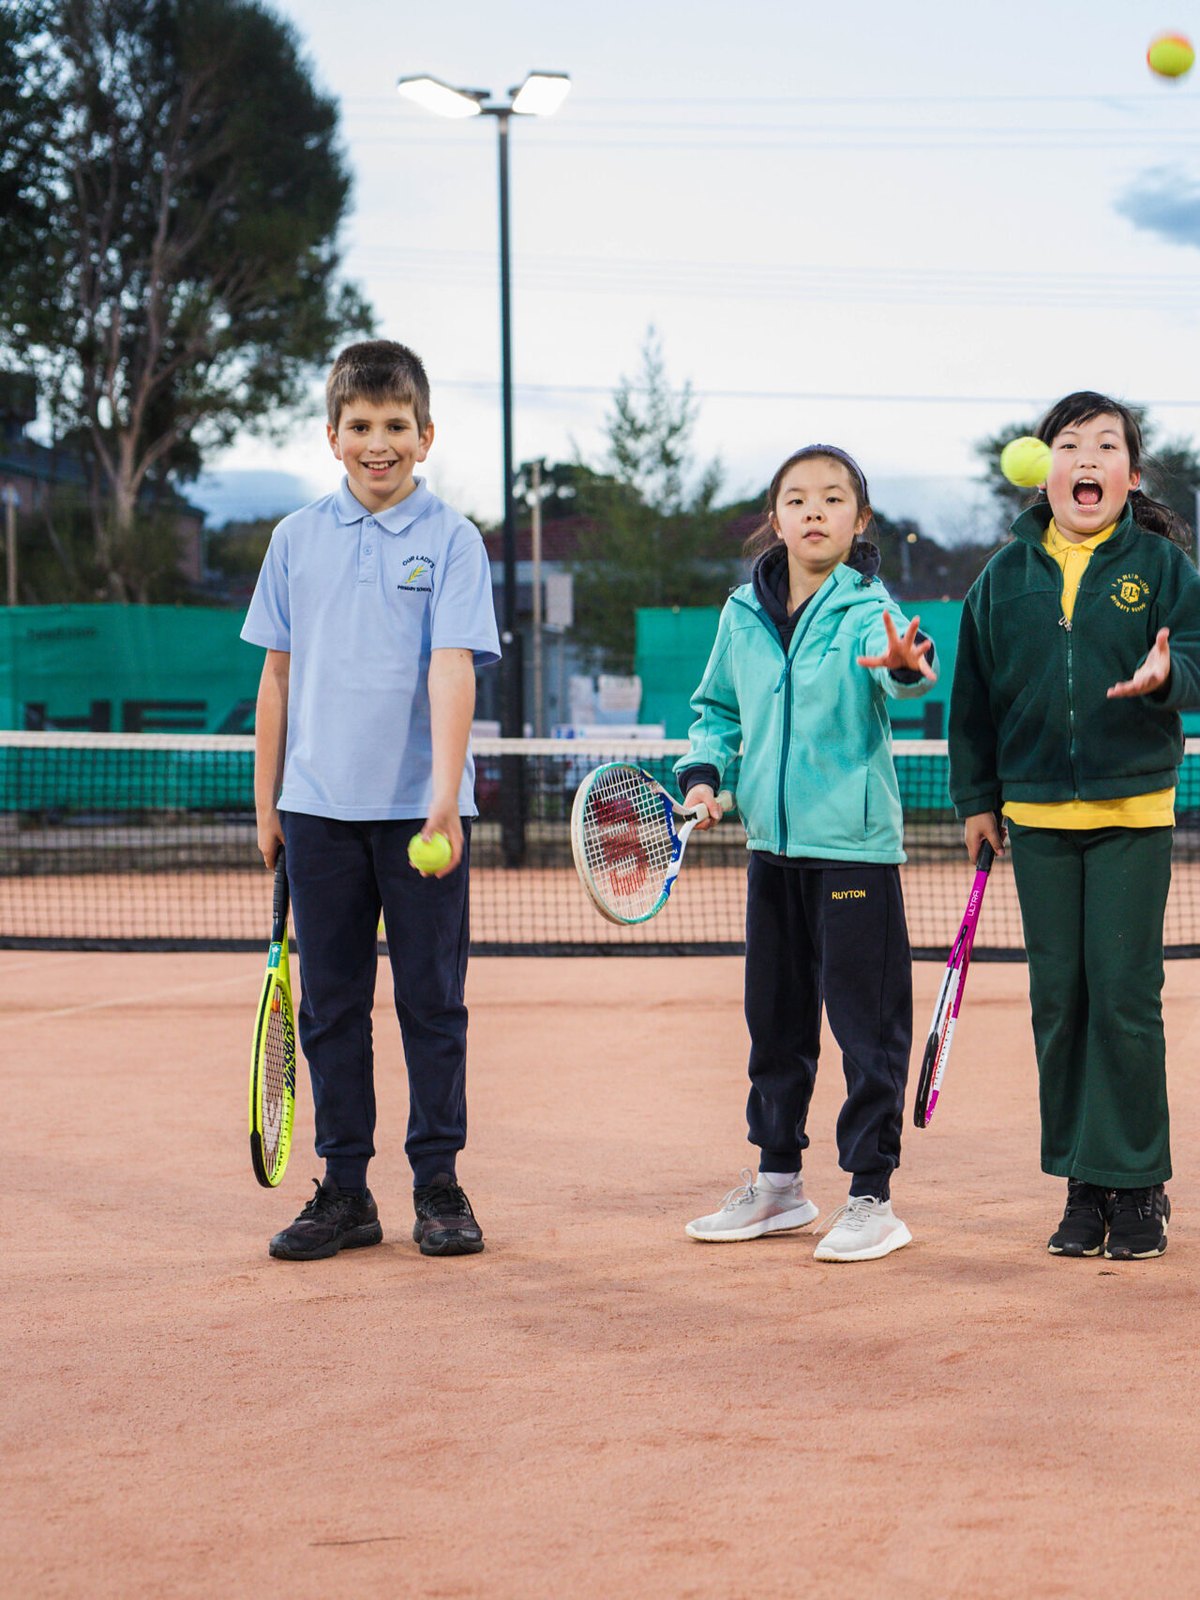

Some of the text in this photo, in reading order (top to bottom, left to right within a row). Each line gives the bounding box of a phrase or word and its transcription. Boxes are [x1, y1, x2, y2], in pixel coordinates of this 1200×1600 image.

[402, 555, 415, 566] OUR
[831, 889, 866, 900] RUYTON
[967, 890, 979, 917] ULTRA
